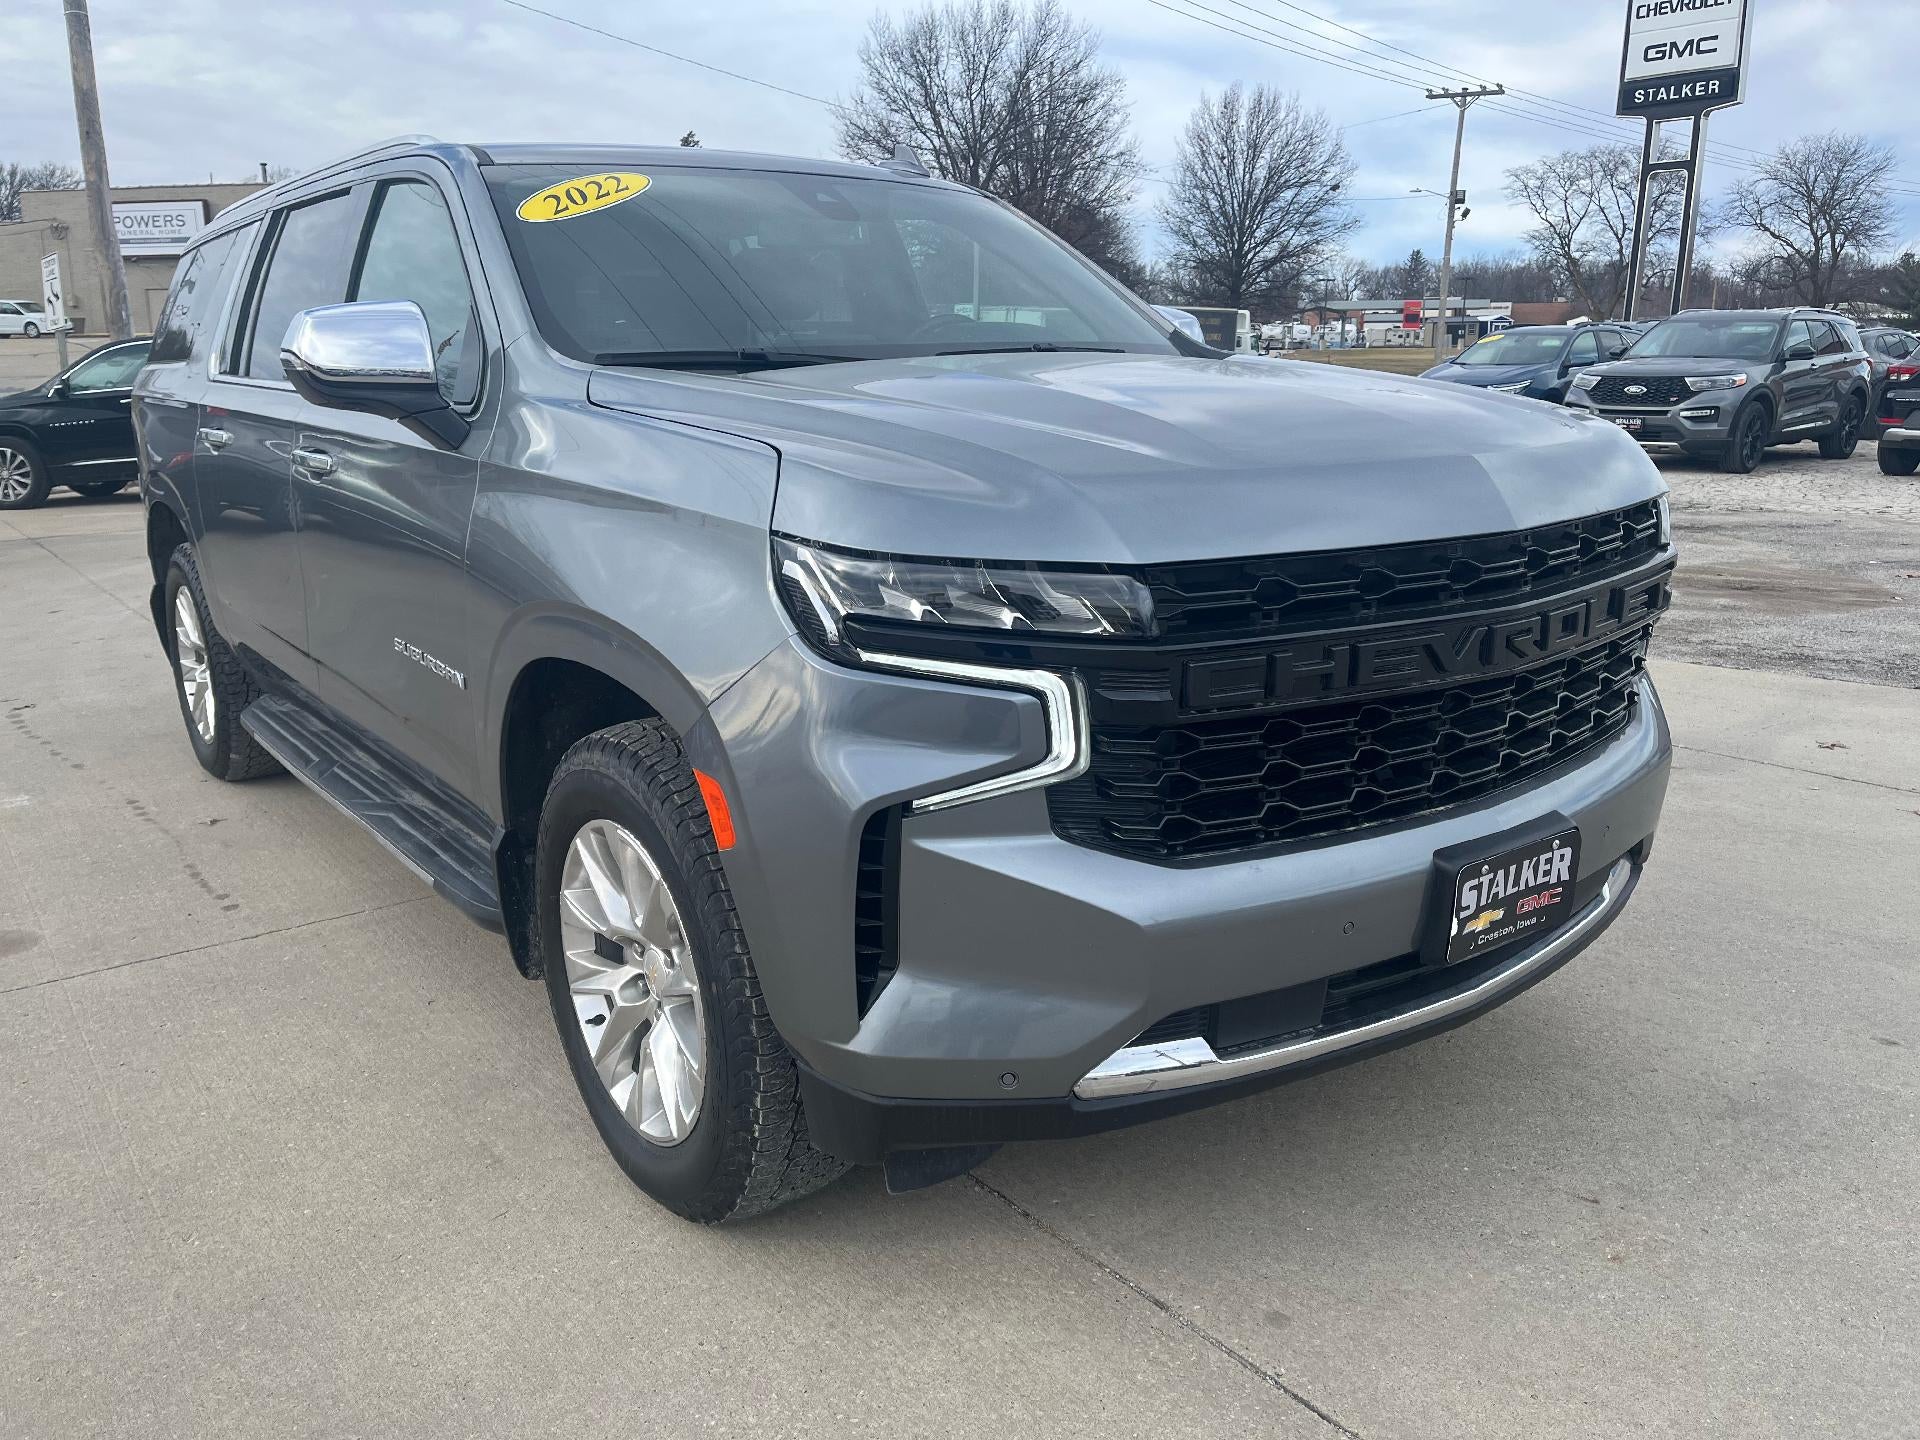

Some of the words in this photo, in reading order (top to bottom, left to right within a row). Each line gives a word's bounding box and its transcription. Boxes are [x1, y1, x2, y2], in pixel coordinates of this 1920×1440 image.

[1636, 0, 1732, 19] CHEVROL
[1643, 35, 1719, 62] GMC
[1634, 80, 1720, 103] STALKER
[543, 175, 629, 216] 2022
[394, 637, 466, 690] SUBURBAN
[1459, 846, 1573, 919] STALKER
[1516, 887, 1562, 914] GMC
[1477, 925, 1516, 945] Creston,
[1517, 915, 1537, 929] Iowa
